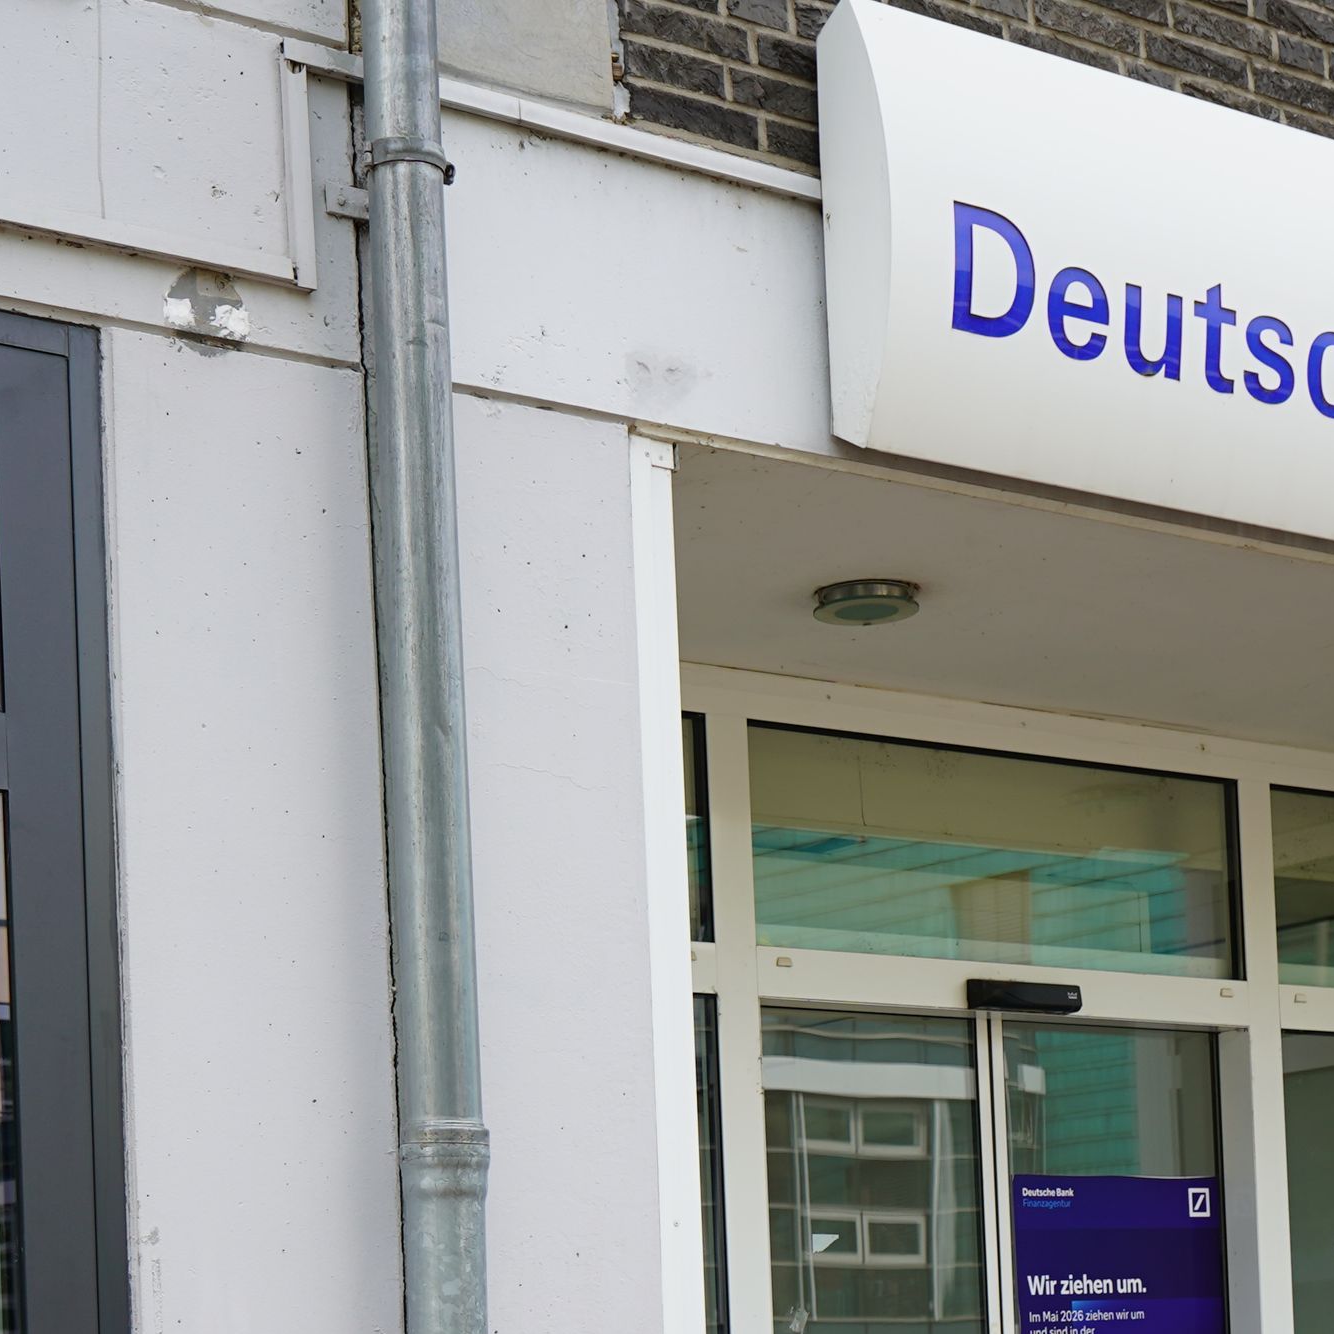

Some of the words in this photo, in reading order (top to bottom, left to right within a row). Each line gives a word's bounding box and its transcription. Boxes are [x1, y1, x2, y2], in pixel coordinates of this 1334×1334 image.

[1022, 1187, 1055, 1197] Deutsche
[1056, 1187, 1074, 1197] Bank
[1023, 1200, 1071, 1208] Finanzagentur
[1027, 1275, 1056, 1295] Wir
[1061, 1274, 1113, 1295] ziehen
[1117, 1278, 1147, 1293] um.
[1029, 1312, 1040, 1322] Im
[1043, 1311, 1058, 1322] Mai
[1061, 1310, 1083, 1322] 2026
[1085, 1310, 1114, 1321] ziehen
[1116, 1309, 1128, 1320] wir
[1131, 1311, 1144, 1319] um
